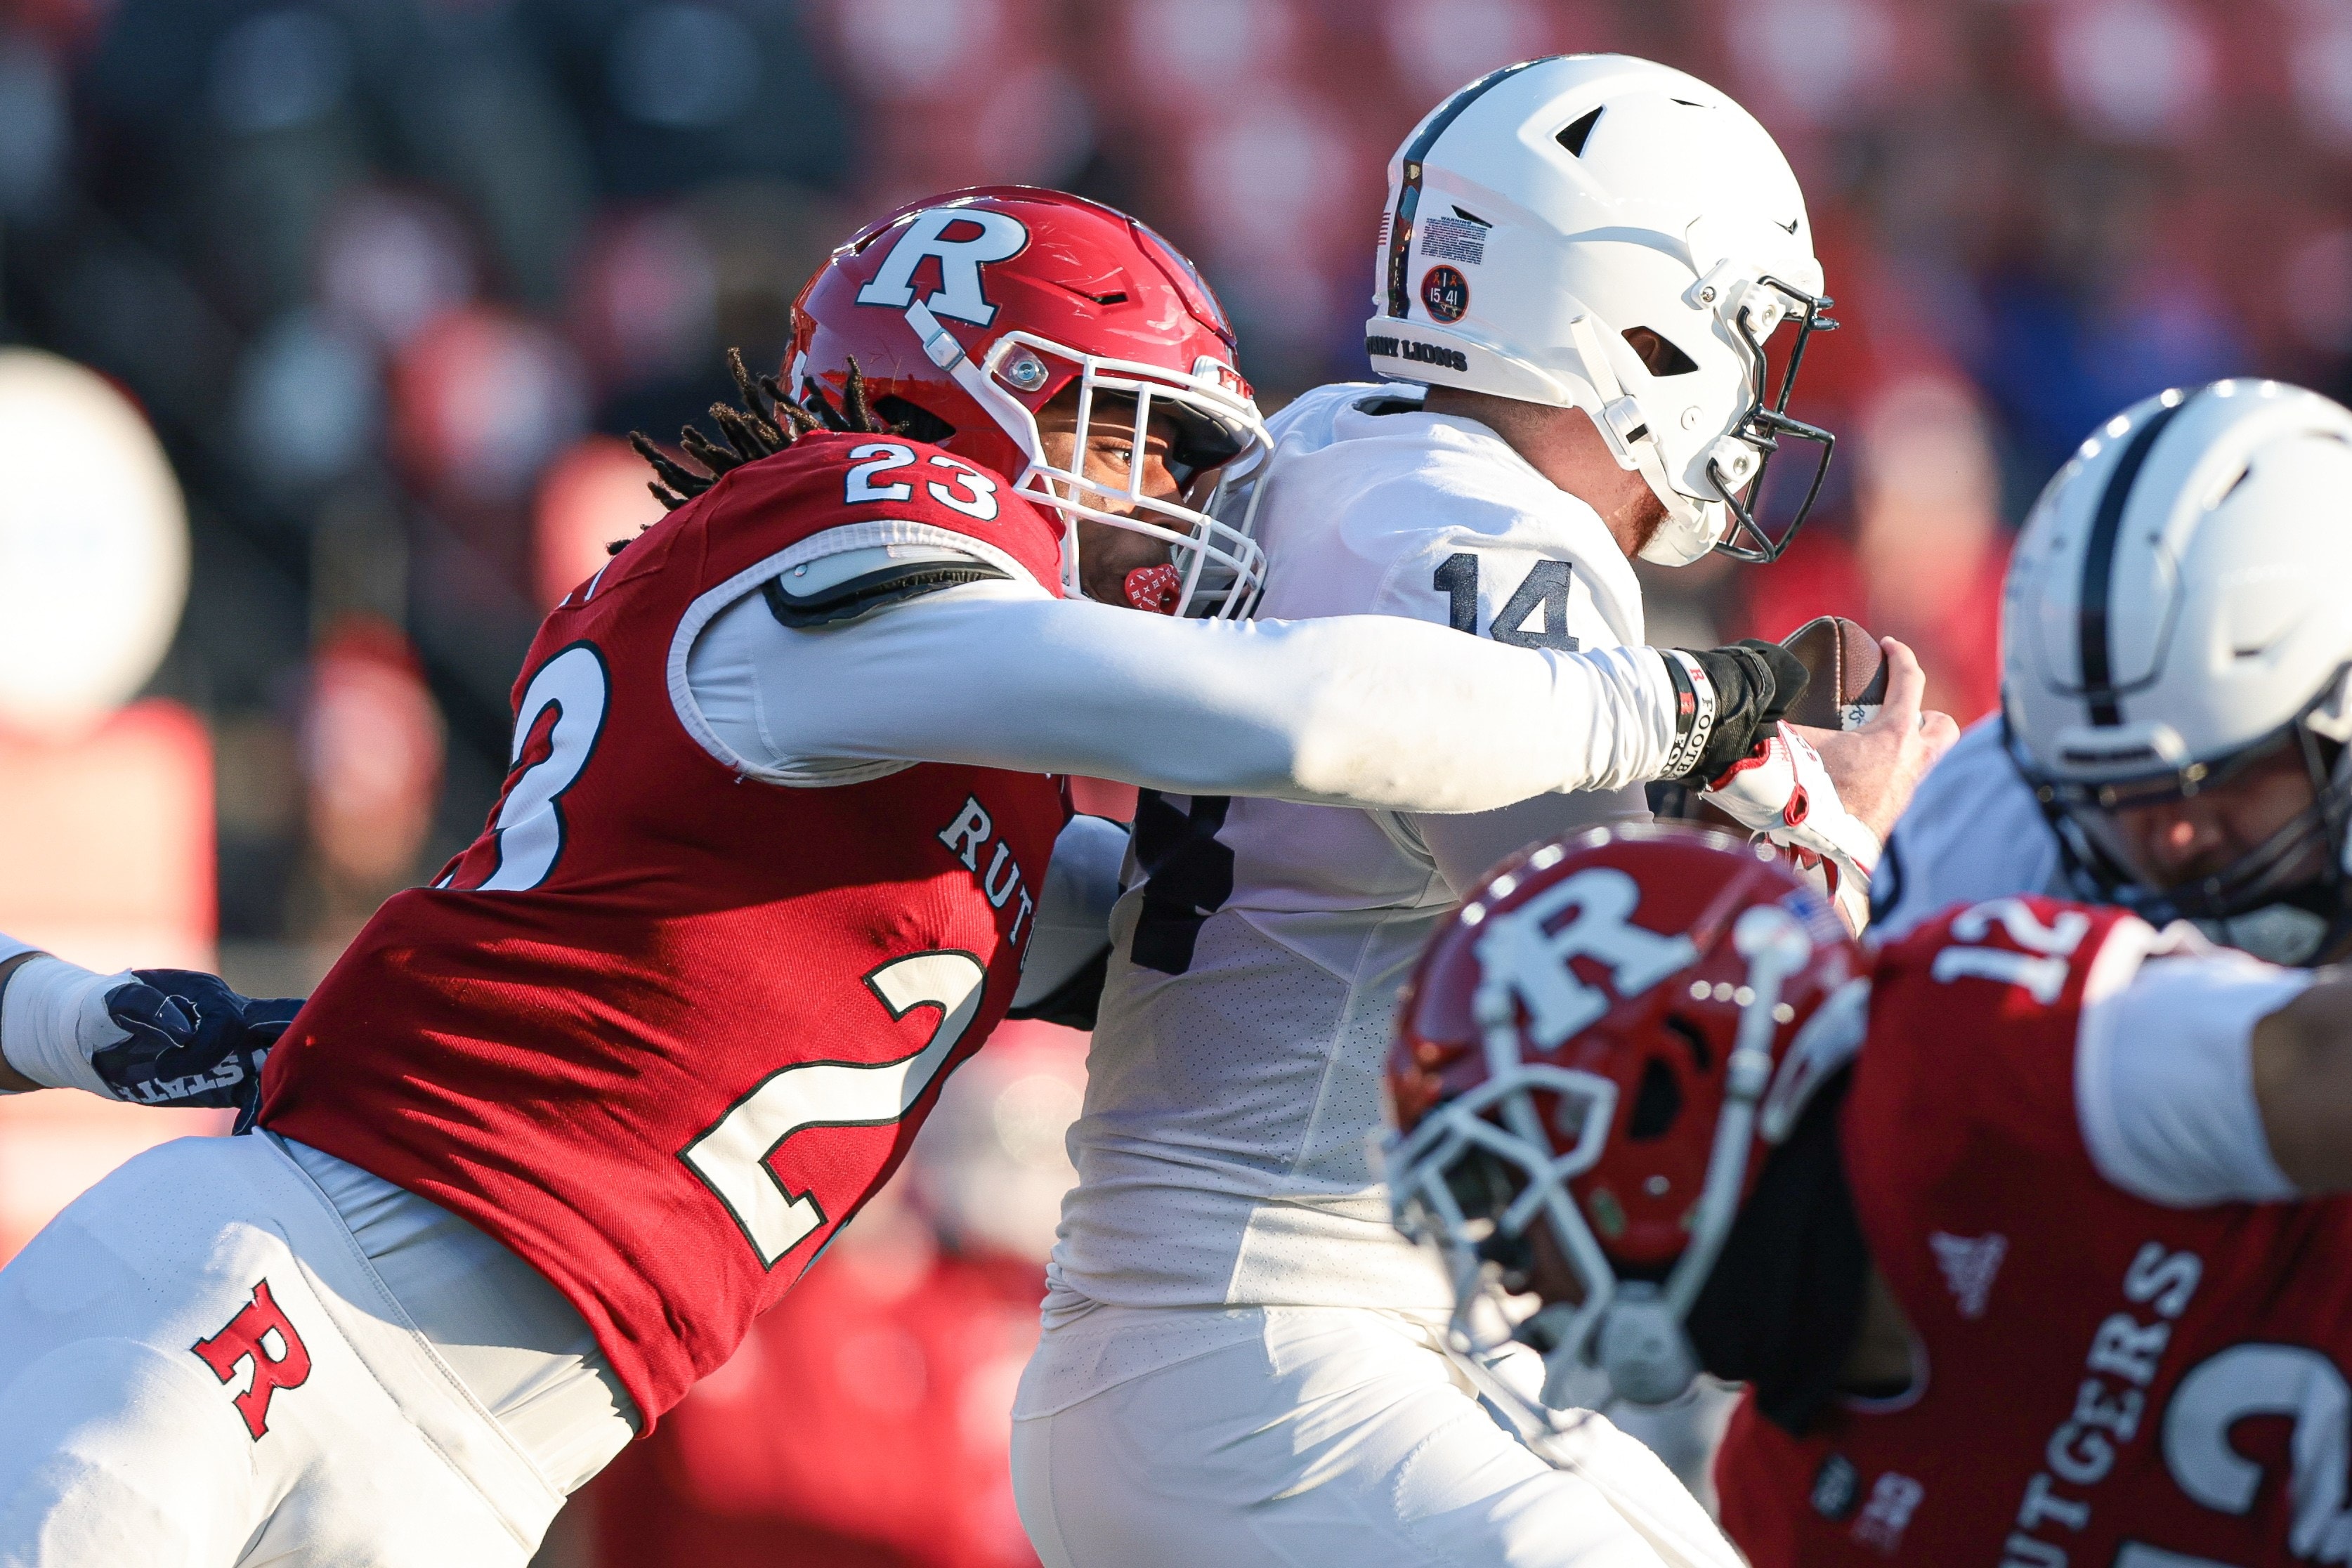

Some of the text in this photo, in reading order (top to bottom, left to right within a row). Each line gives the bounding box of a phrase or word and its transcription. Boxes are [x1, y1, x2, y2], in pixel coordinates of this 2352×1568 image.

[855, 206, 1031, 329] R
[1430, 287, 1458, 305] 15 41
[1401, 340, 1468, 372] LIONS
[844, 443, 999, 522] 23
[1433, 552, 1579, 652] 14
[936, 792, 1035, 971] RUT
[1472, 865, 1701, 1052] R
[1931, 898, 2091, 1005] 12
[677, 948, 988, 1273] 2
[190, 1277, 312, 1442] R
